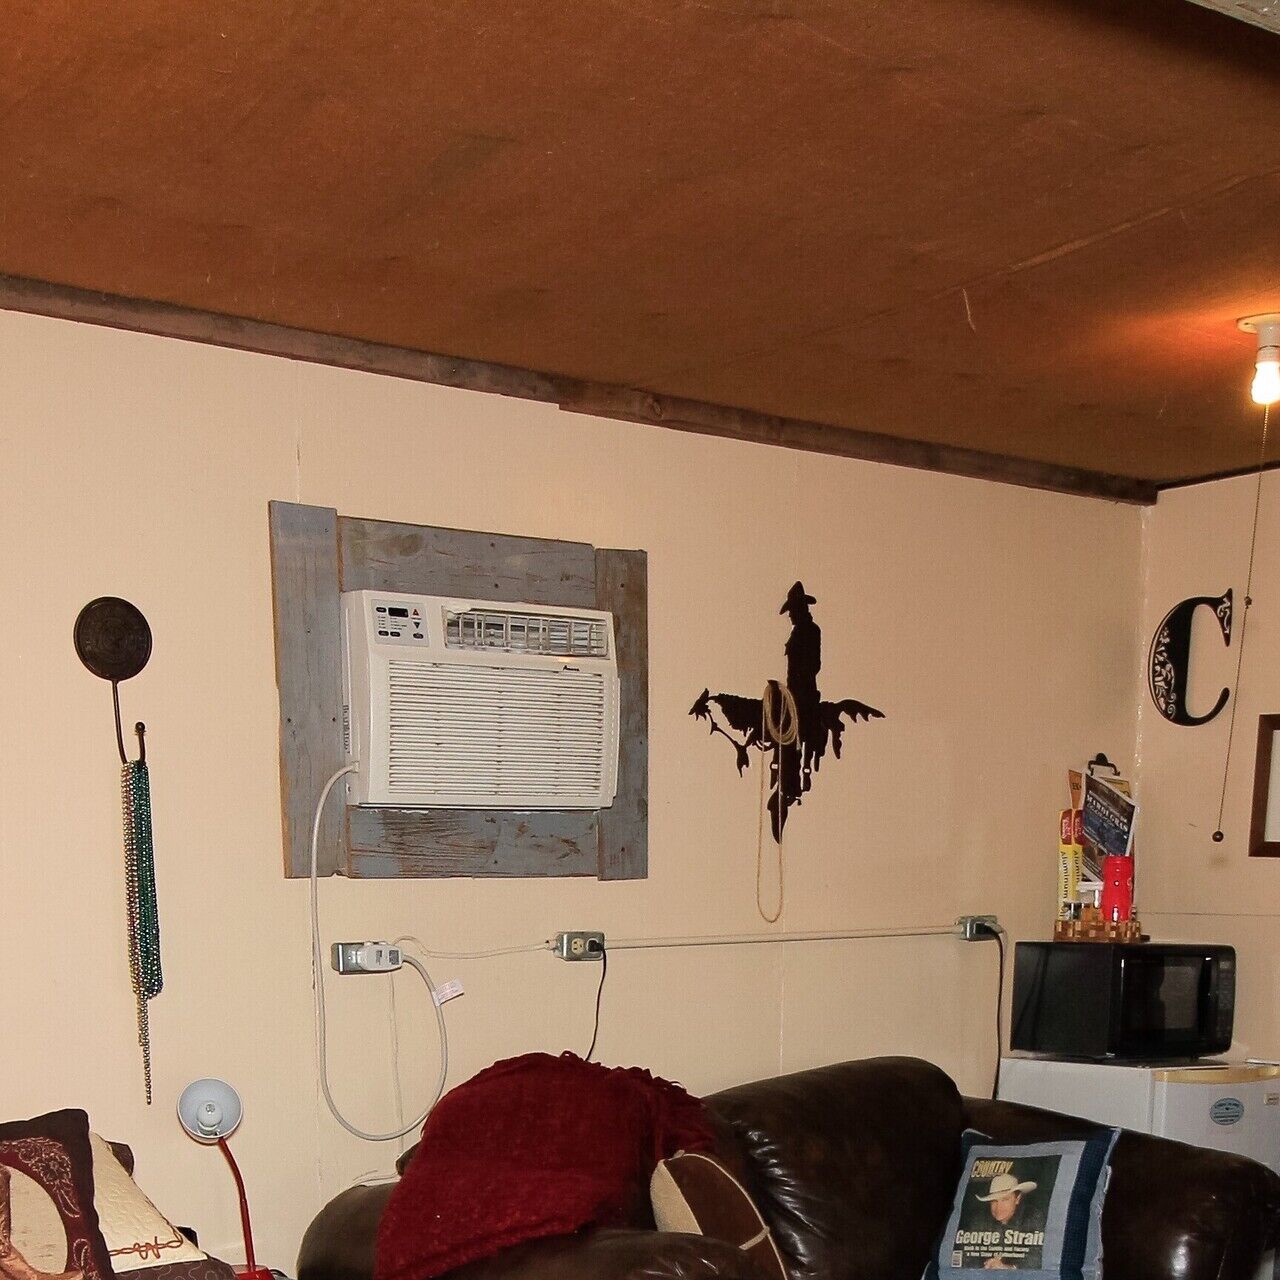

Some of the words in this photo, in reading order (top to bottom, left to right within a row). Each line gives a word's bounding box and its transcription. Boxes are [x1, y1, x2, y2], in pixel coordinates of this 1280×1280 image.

[1147, 587, 1233, 726] C
[955, 1229, 1000, 1246] George
[1003, 1229, 1044, 1246] Strait
